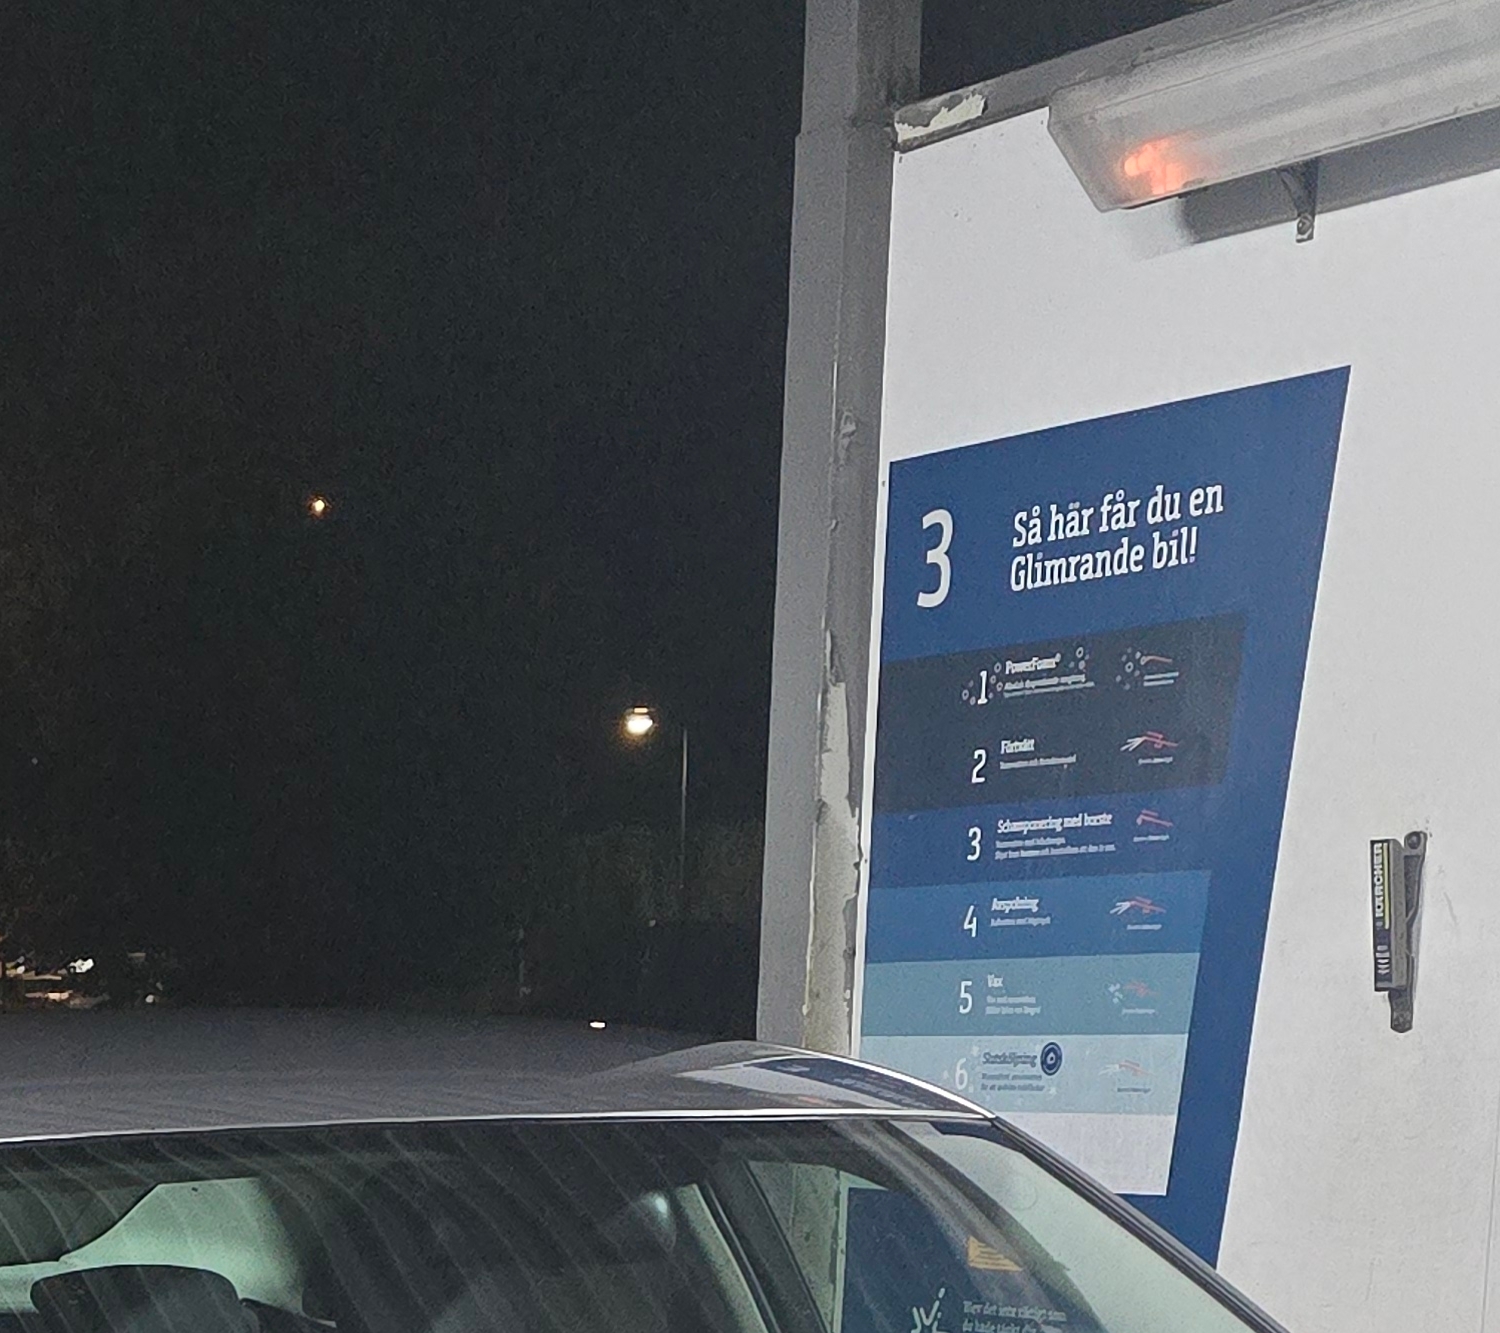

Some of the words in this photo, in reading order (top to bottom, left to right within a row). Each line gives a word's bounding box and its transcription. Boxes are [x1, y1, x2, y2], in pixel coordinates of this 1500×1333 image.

[1013, 505, 1042, 547] Så
[1048, 502, 1094, 541] här
[1099, 490, 1141, 533] får
[1146, 485, 1182, 525] du
[1189, 484, 1224, 517] en
[916, 508, 955, 609] 3
[1010, 537, 1145, 592] Glimrande
[1152, 526, 1198, 570] bil!
[977, 670, 989, 704] 1
[971, 749, 987, 784] 2
[966, 826, 982, 861] 3
[963, 905, 977, 938] 4
[959, 980, 973, 1014] 5
[955, 1057, 968, 1090] 6
